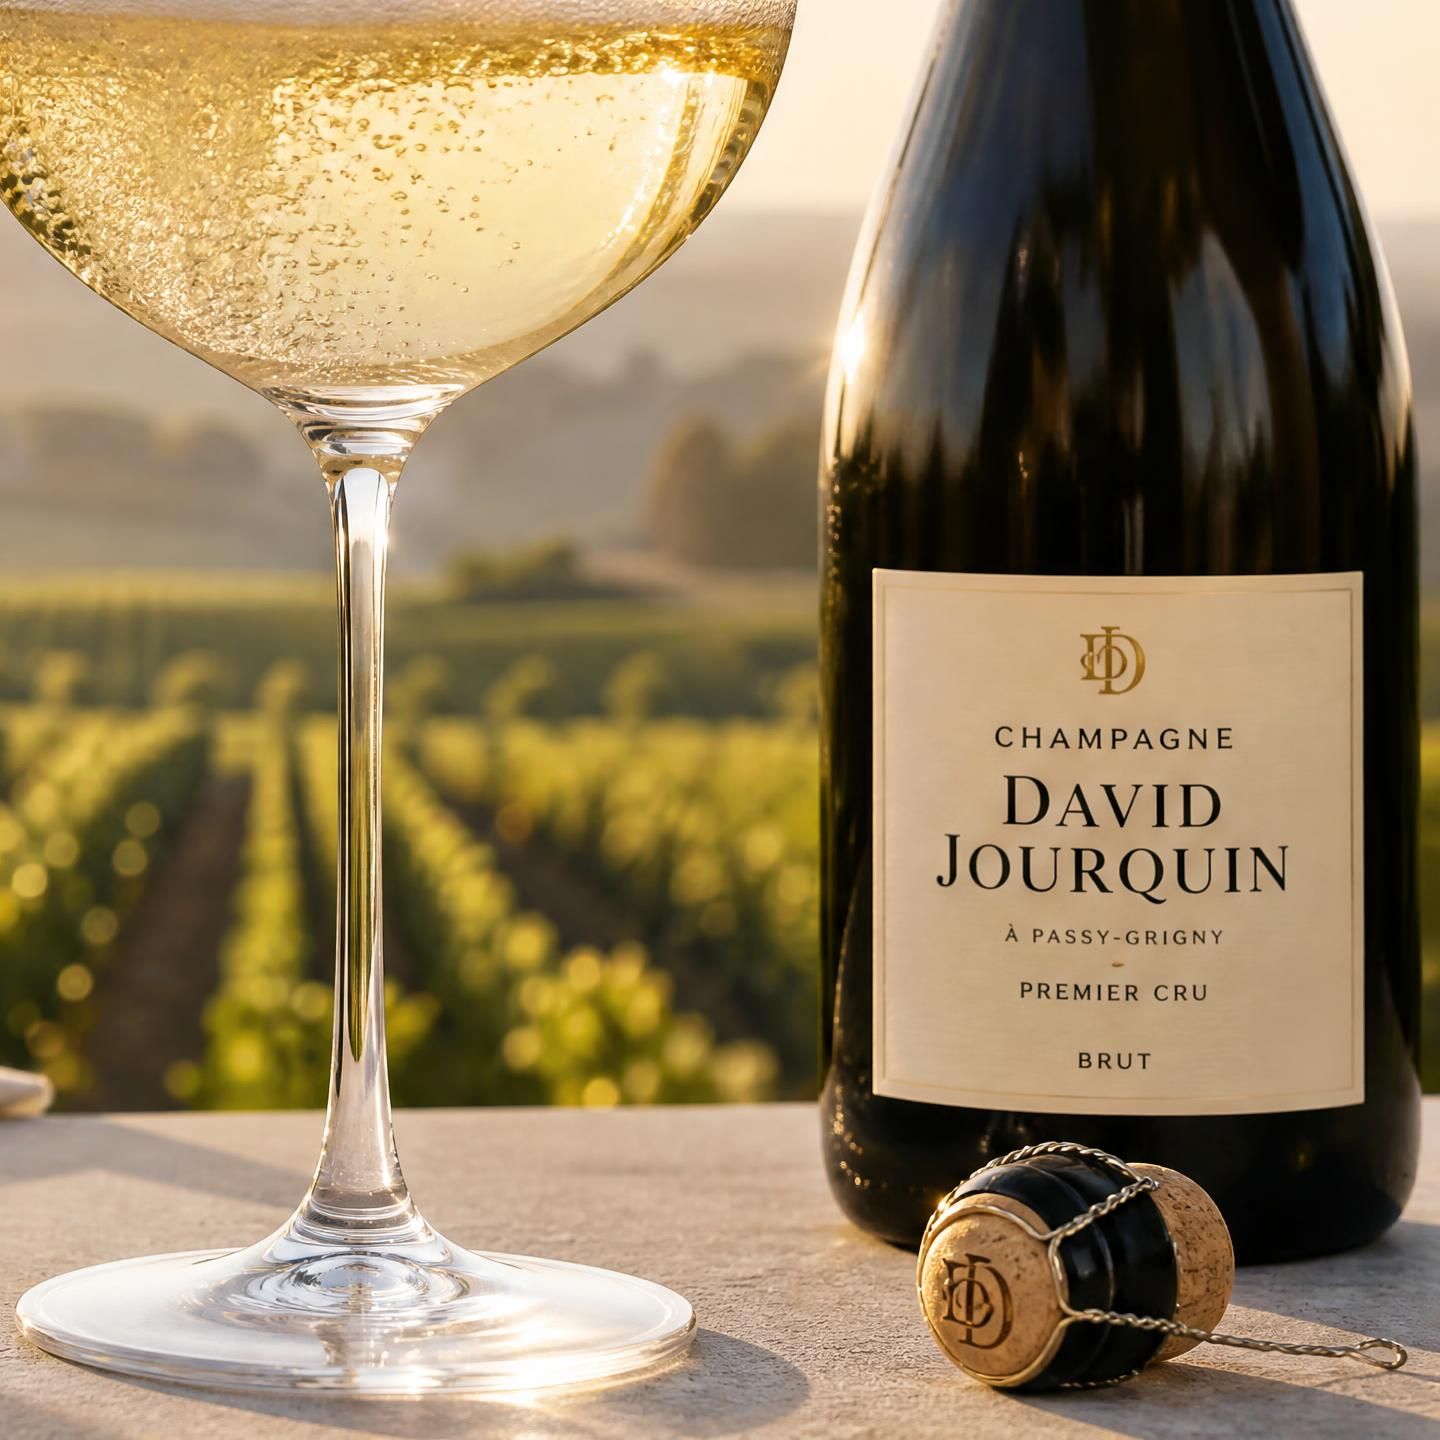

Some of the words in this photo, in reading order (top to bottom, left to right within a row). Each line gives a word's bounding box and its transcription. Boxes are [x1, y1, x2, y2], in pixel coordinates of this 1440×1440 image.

[994, 725, 1235, 751] CHAMPAGNE
[1001, 774, 1222, 829] DAVID
[935, 833, 1290, 905] JOURQUIN
[1004, 923, 1020, 944] À
[1032, 927, 1224, 946] PASSY-GRIGNY
[1019, 981, 1140, 1003] PREMIER
[1153, 984, 1209, 1003] CRU
[1078, 1051, 1152, 1071] BRUT
